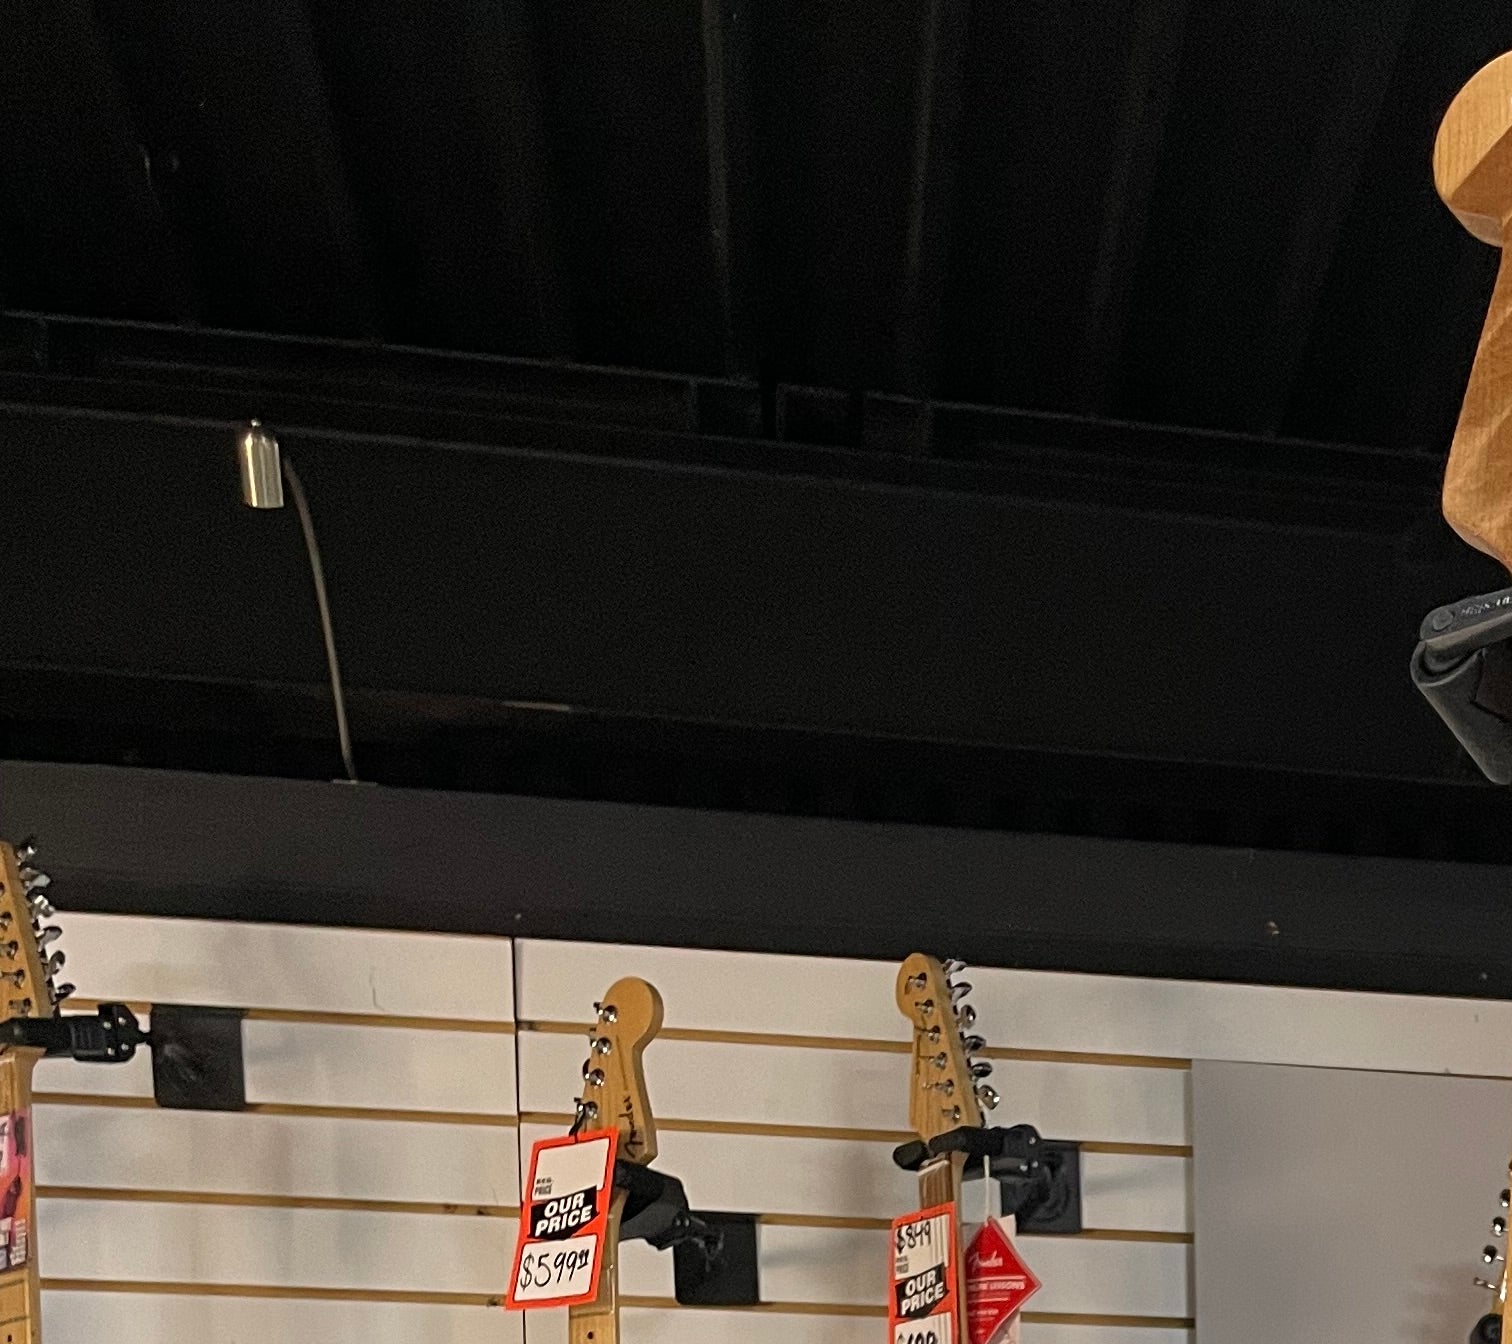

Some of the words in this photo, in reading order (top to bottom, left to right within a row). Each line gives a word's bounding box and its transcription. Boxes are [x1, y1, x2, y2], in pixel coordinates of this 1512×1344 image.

[543, 1192, 586, 1219] OUR
[534, 1204, 593, 1238] PRICE
[905, 1270, 937, 1296] OUR
[901, 1281, 945, 1316] PRICE
